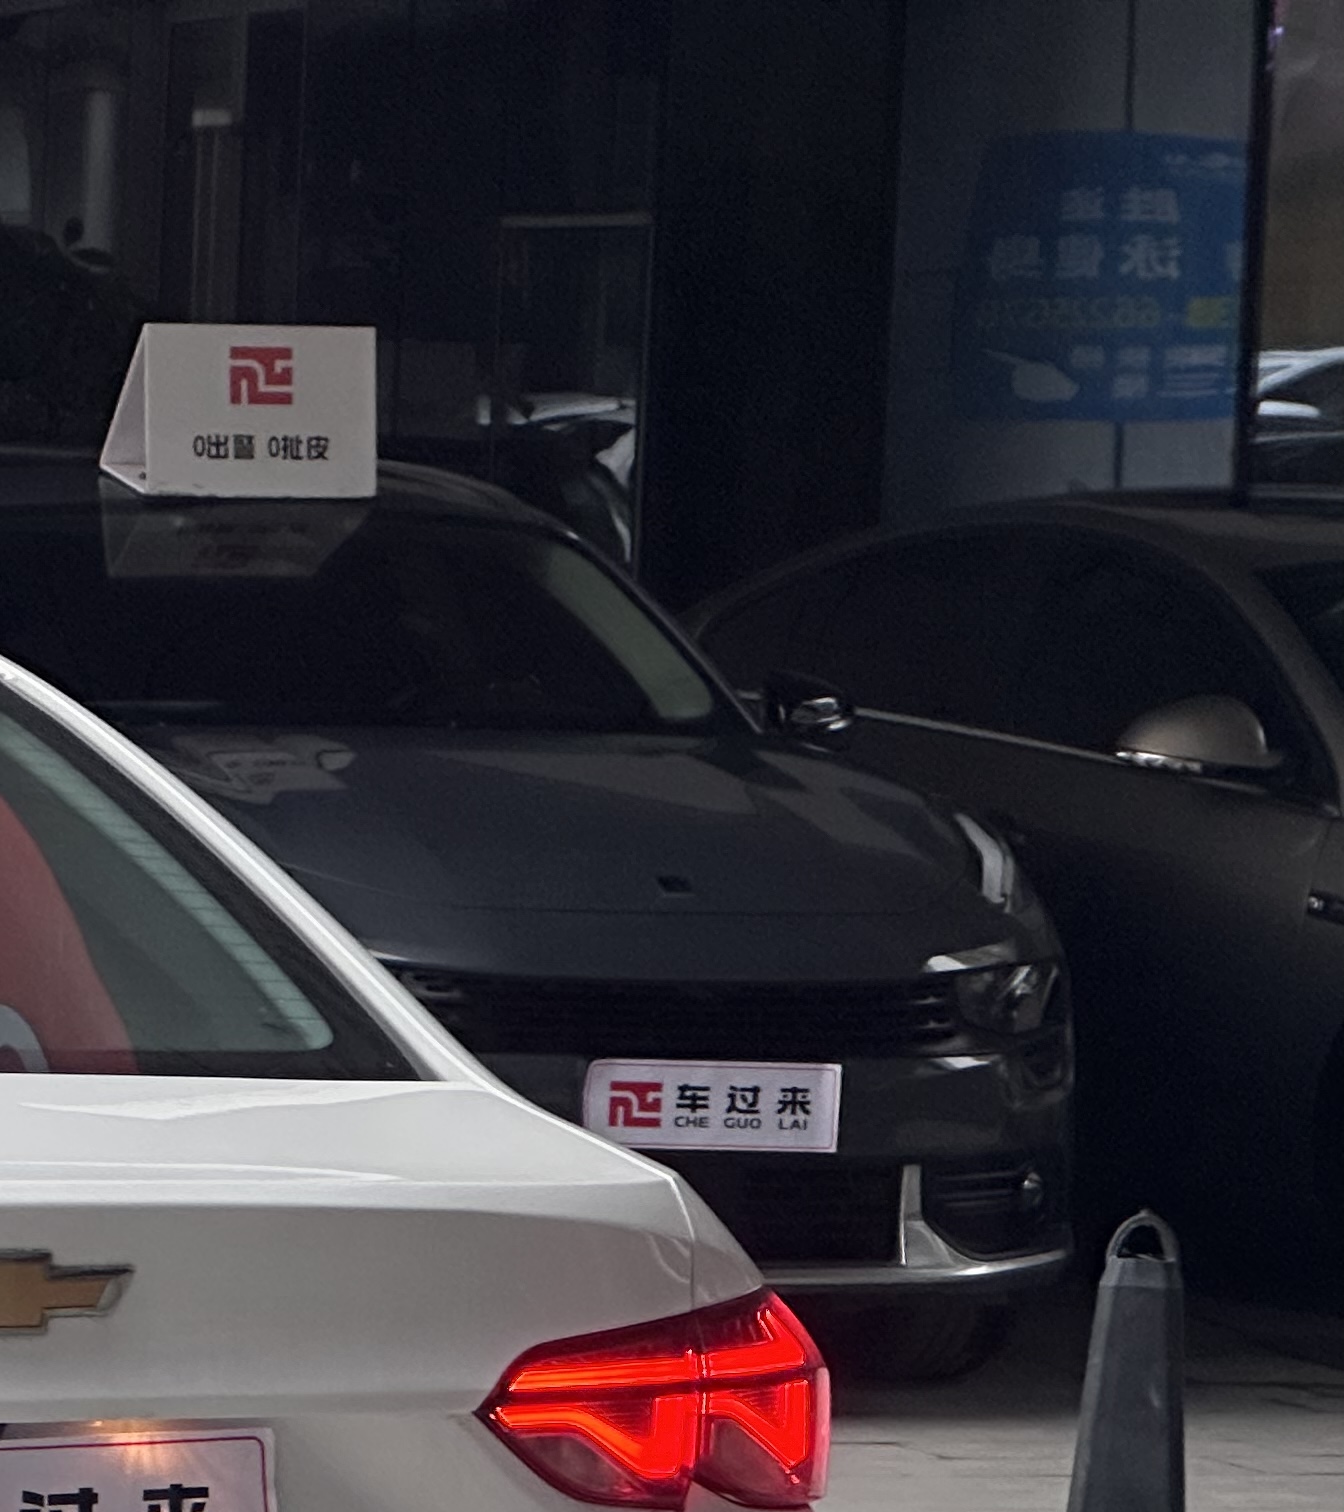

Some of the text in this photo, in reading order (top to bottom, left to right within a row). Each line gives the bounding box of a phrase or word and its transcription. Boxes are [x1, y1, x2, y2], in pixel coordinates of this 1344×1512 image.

[676, 1083, 811, 1116] 车过来
[674, 1115, 808, 1131] CHE GUO LAI
